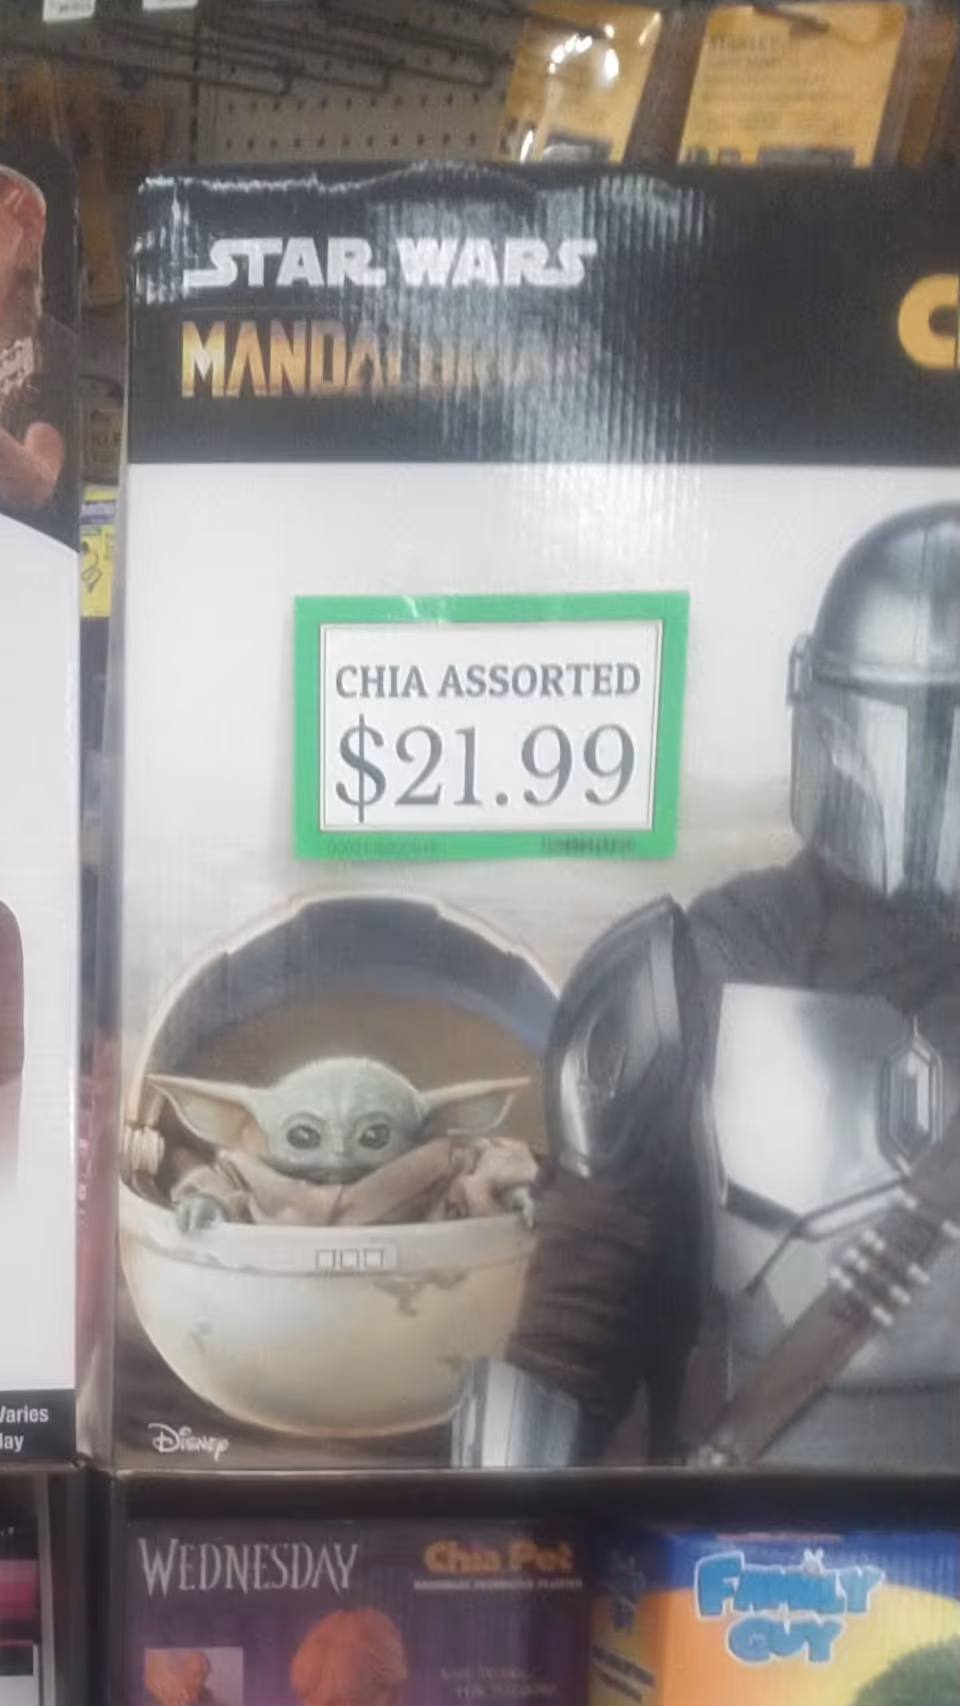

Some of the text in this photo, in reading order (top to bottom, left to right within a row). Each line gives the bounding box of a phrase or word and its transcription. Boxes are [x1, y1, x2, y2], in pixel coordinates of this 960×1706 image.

[183, 237, 598, 288] STAR WARS
[335, 662, 641, 698] CHIA ASSORTED
[335, 713, 635, 823] $21.99
[148, 1423, 229, 1461] Disney
[139, 1538, 358, 1597] WEDNESDAY
[424, 1539, 574, 1574] Chia Pet
